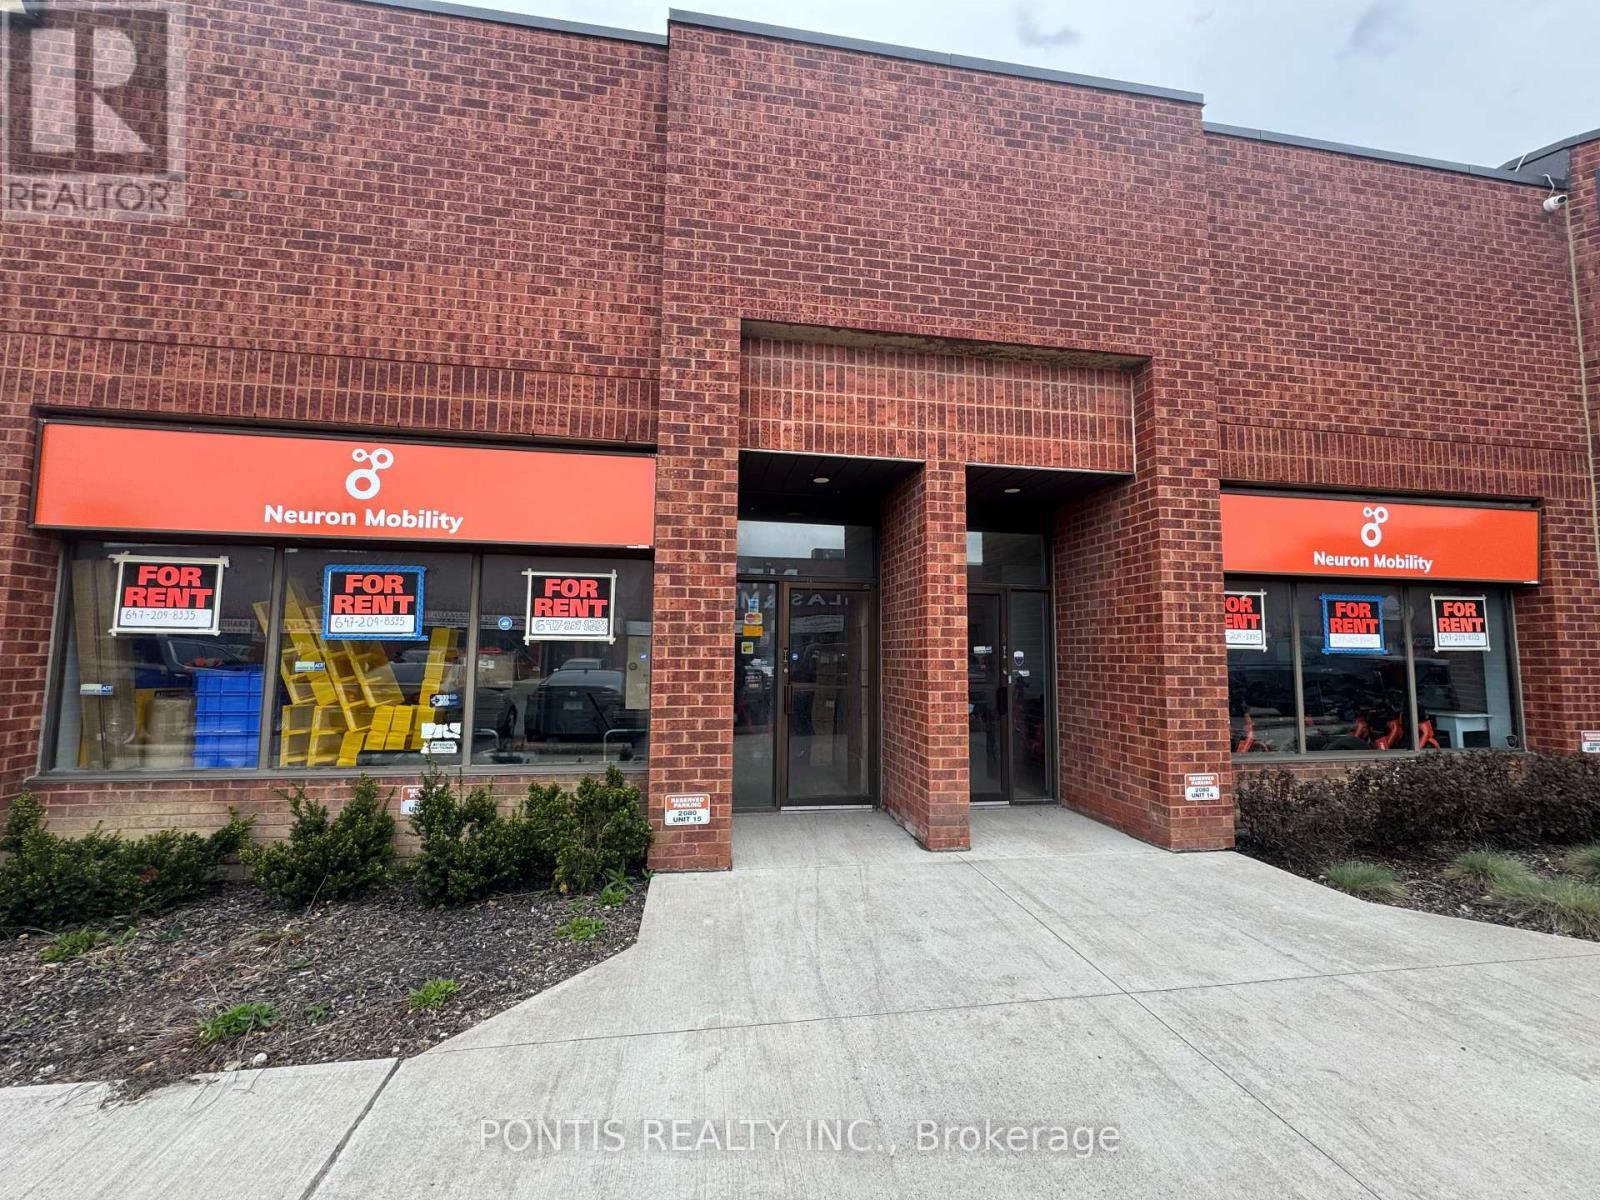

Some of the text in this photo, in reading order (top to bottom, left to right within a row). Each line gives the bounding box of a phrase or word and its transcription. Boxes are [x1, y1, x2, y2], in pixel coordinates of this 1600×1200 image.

[264, 504, 464, 534] Neuron Mobility
[1313, 551, 1433, 573] Neuron Mobility
[138, 565, 202, 587] FOR
[345, 574, 404, 594] FOR
[124, 586, 213, 608] RENT
[545, 578, 598, 598] FOR
[333, 594, 414, 615] RENT
[534, 598, 608, 617] RENT
[1224, 597, 1253, 613] OR
[1335, 602, 1370, 618] FOR
[1443, 602, 1477, 616] FOR
[125, 609, 196, 621] 647-209-8335
[334, 615, 405, 629] 647-209-8335
[1224, 613, 1260, 630] ENT
[1330, 618, 1379, 634] RENT
[1438, 617, 1484, 633] RENT
